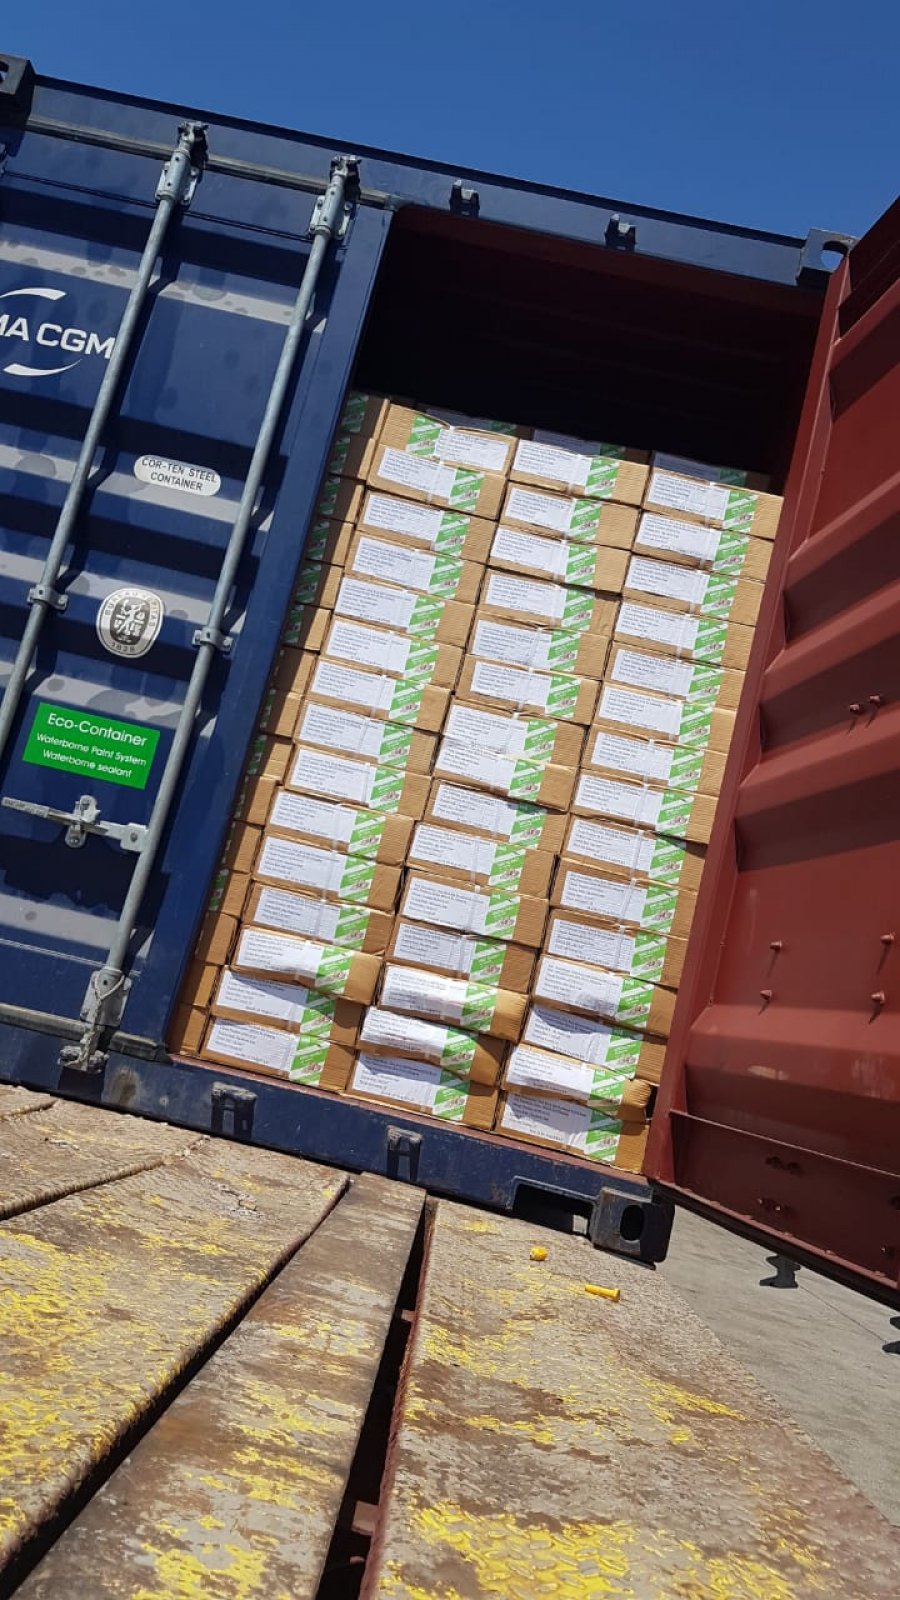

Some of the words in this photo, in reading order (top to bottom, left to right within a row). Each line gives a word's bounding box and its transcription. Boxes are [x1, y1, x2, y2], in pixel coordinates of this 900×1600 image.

[36, 323, 116, 359] CGM
[141, 458, 184, 474] COR-TEN
[188, 467, 216, 483] STEEL
[150, 472, 203, 491] CONTAINER
[47, 712, 147, 746] Eco-Container
[36, 732, 89, 752] Waterborne
[91, 746, 113, 759] Paint
[114, 752, 147, 767] System
[43, 749, 95, 770] Waterborne
[97, 764, 132, 778] sealant
